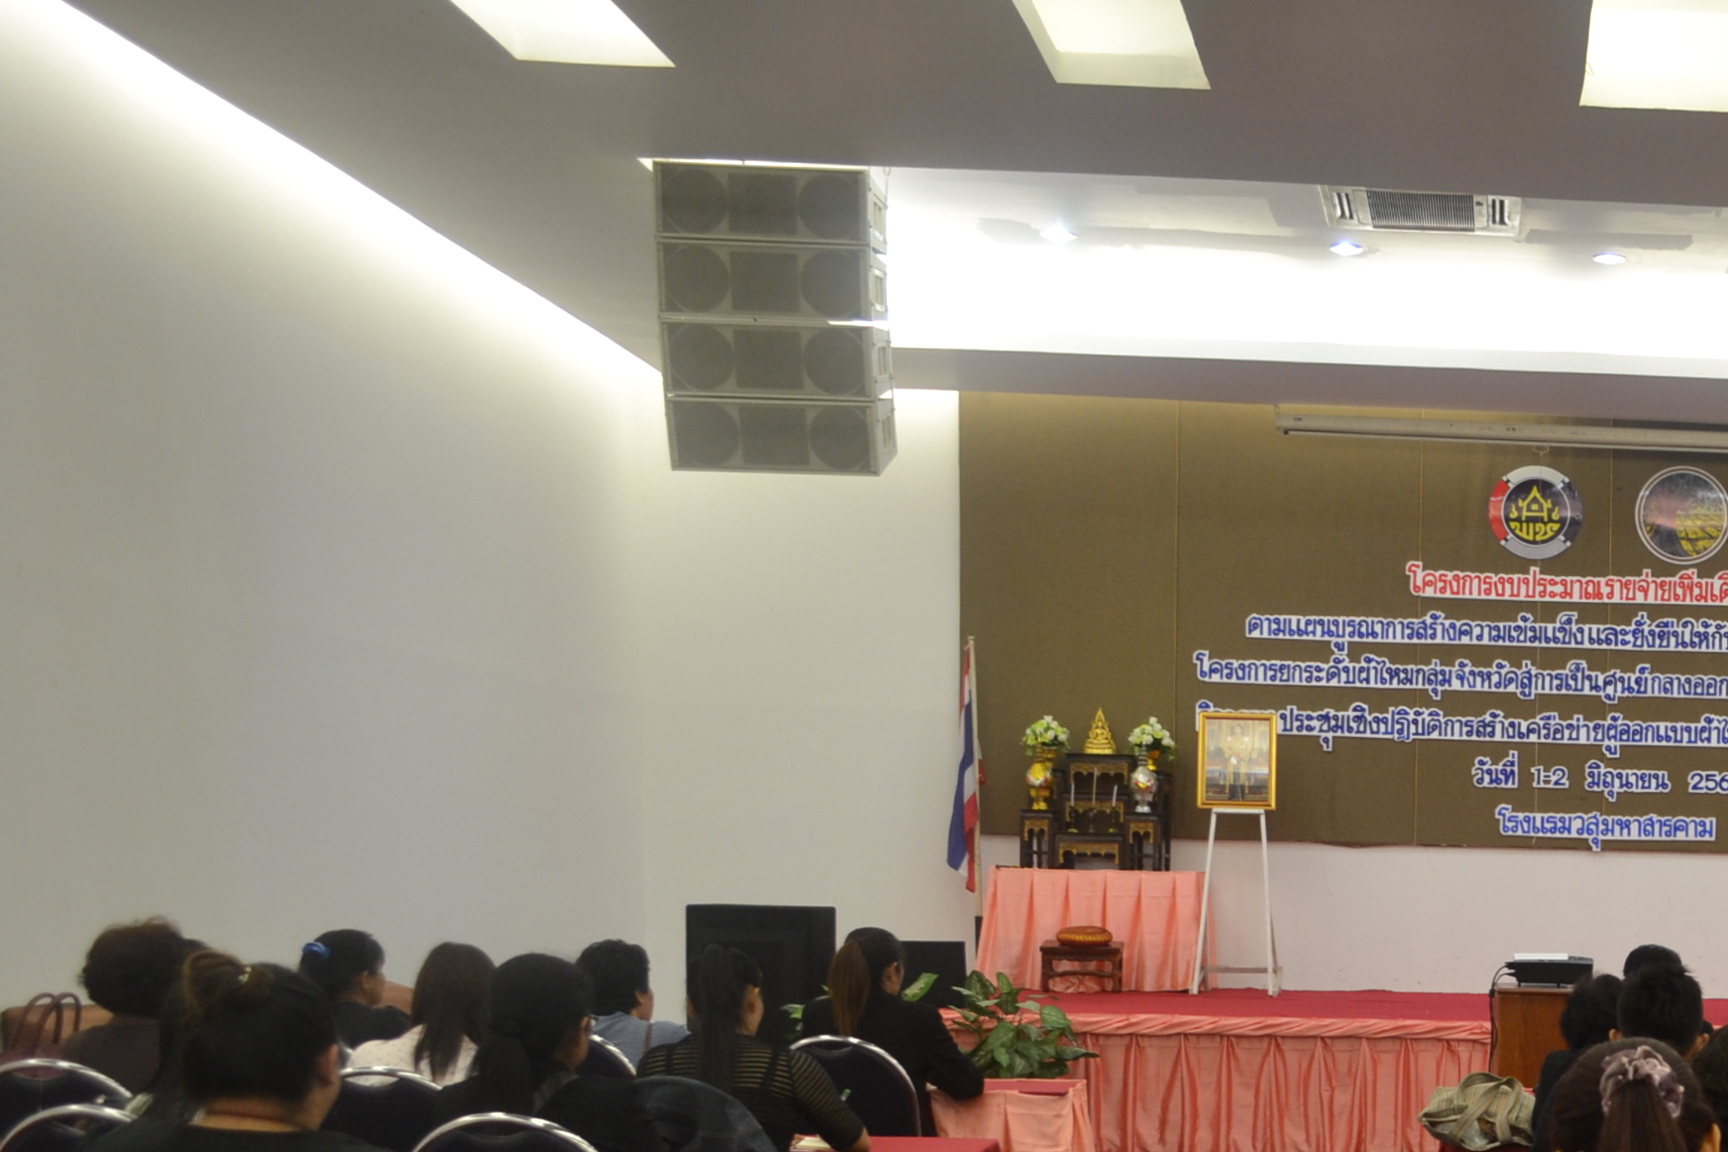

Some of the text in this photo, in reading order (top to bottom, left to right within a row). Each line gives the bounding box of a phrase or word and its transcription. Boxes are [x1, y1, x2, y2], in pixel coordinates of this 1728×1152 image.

[1474, 752, 1517, 786] วันที่
[1534, 767, 1567, 786] 1-2
[1587, 761, 1669, 800] มิถุนายน
[1498, 807, 1714, 848] โรงแรมวสุมหาสารคาม
